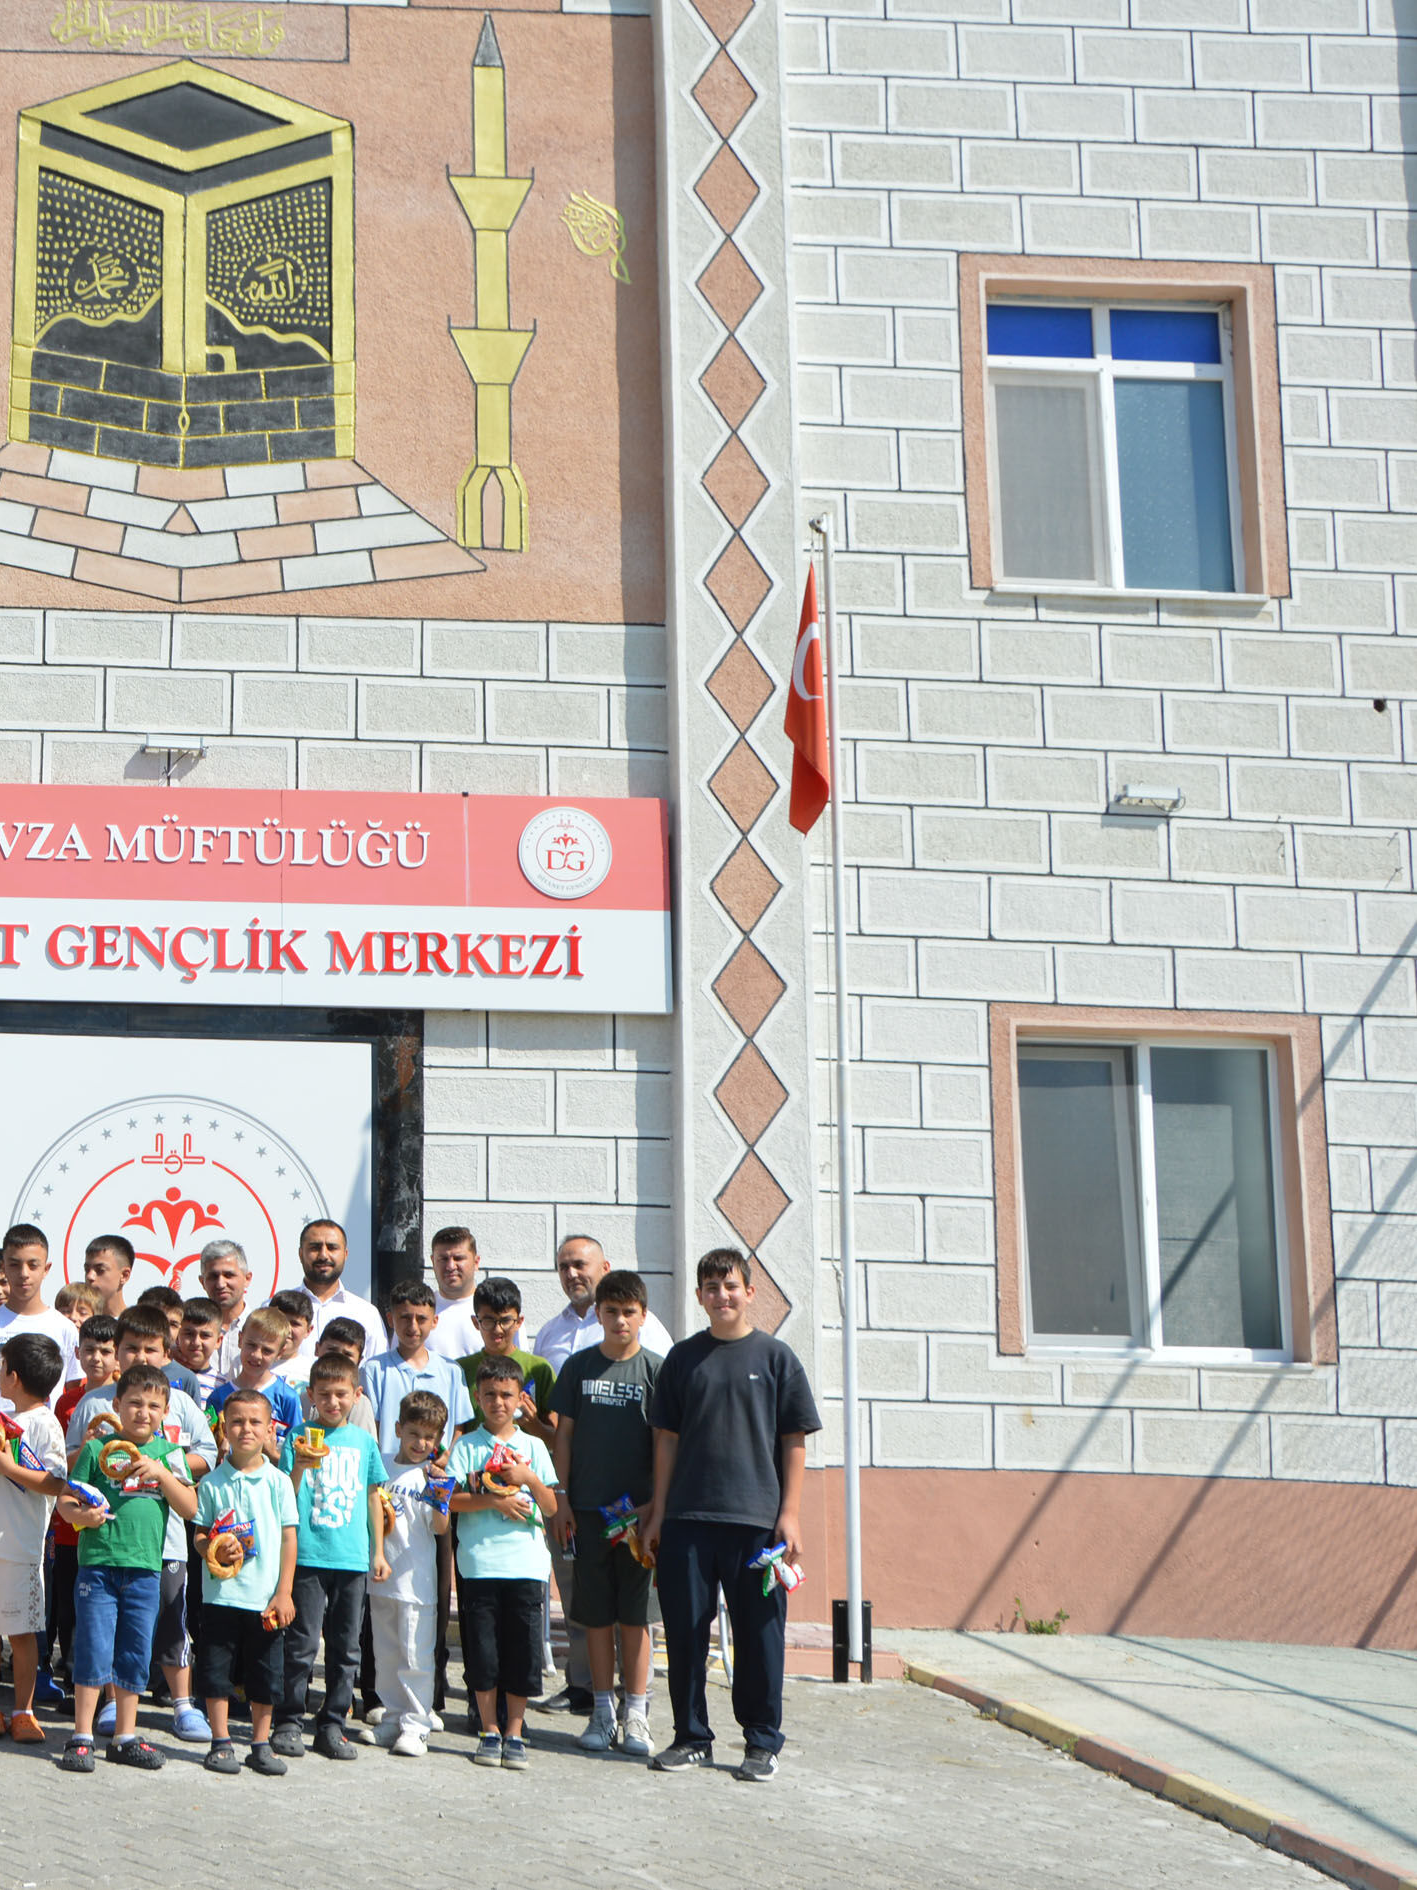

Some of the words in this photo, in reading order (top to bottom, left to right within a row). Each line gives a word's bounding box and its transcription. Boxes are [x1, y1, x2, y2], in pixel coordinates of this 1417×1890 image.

[245, 254, 294, 301] الله
[104, 814, 431, 869] MÜFTÜLÜĞÜ
[545, 849, 586, 872] DG
[45, 916, 309, 983] GENÇLİK
[324, 924, 584, 981] MERKEZİ
